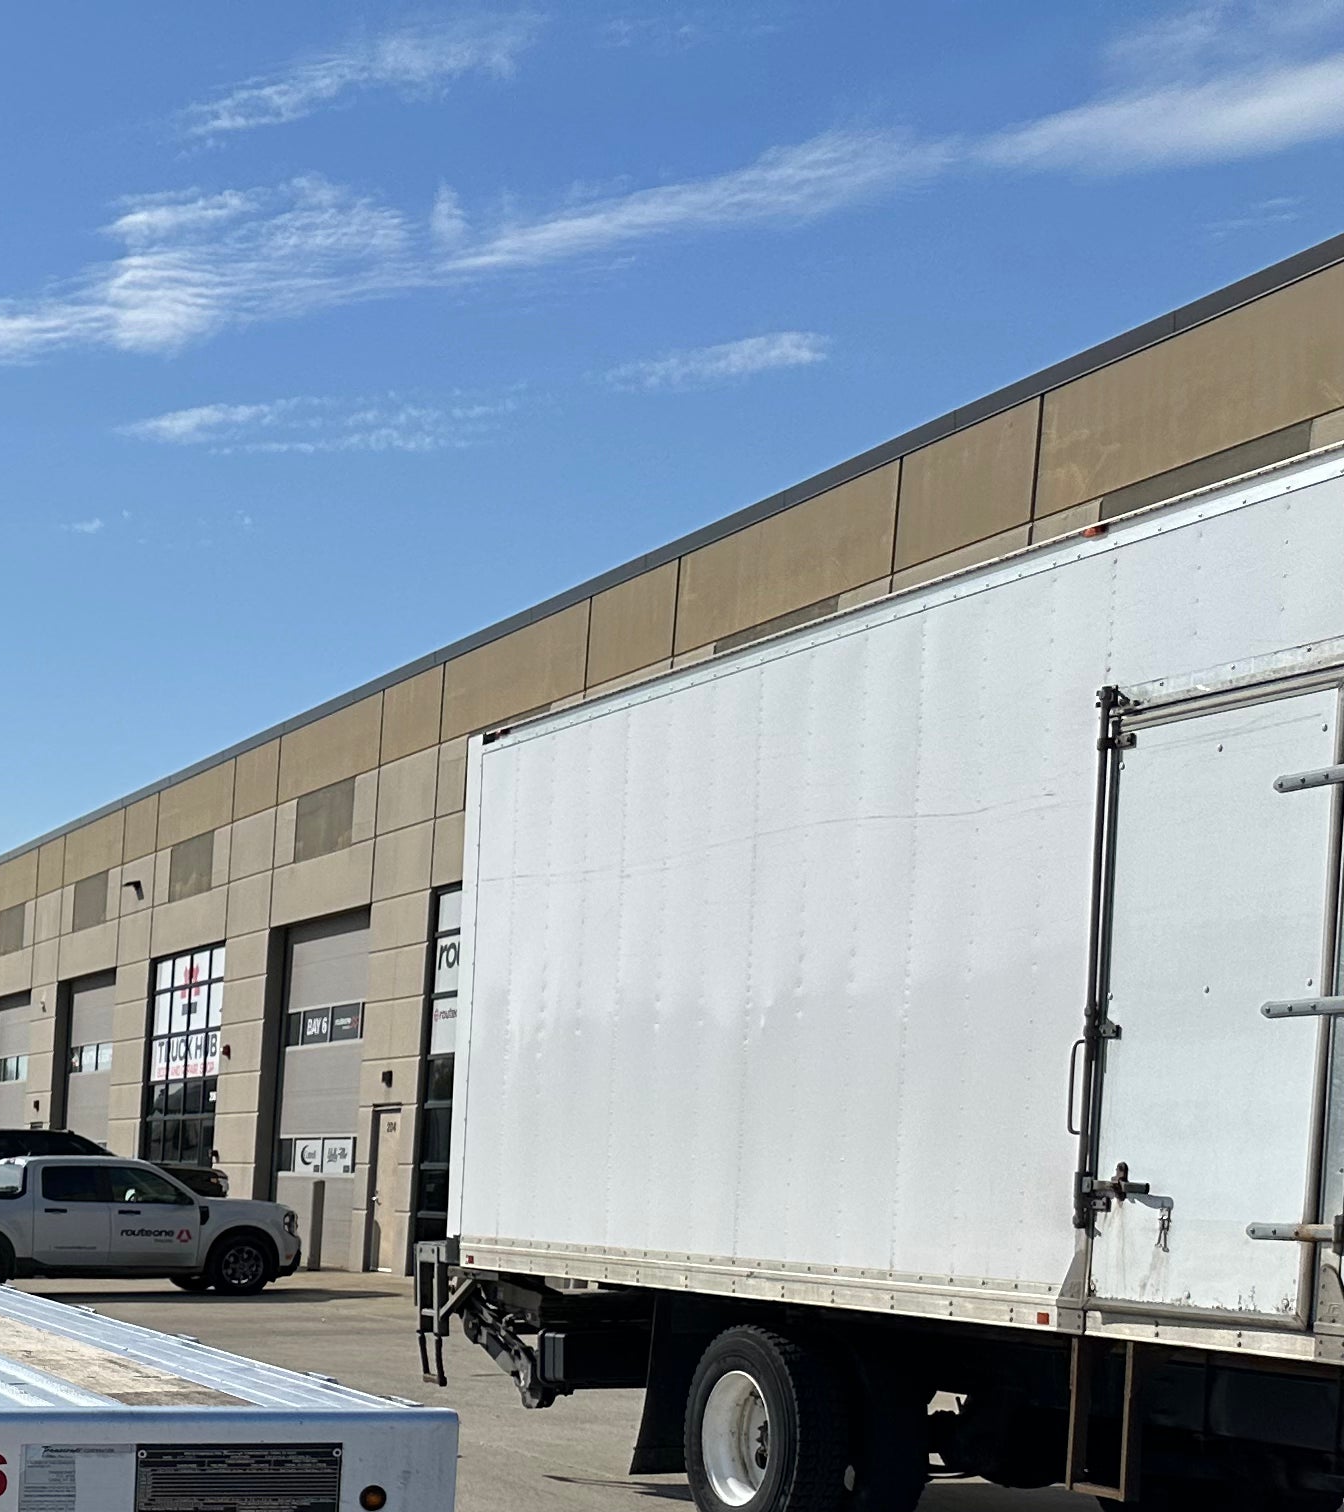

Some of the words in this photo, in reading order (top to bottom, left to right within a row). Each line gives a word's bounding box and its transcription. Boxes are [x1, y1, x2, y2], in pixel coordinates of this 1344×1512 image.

[307, 1017, 322, 1036] BAY
[321, 1016, 328, 1034] 6
[120, 1228, 175, 1237] routeone
